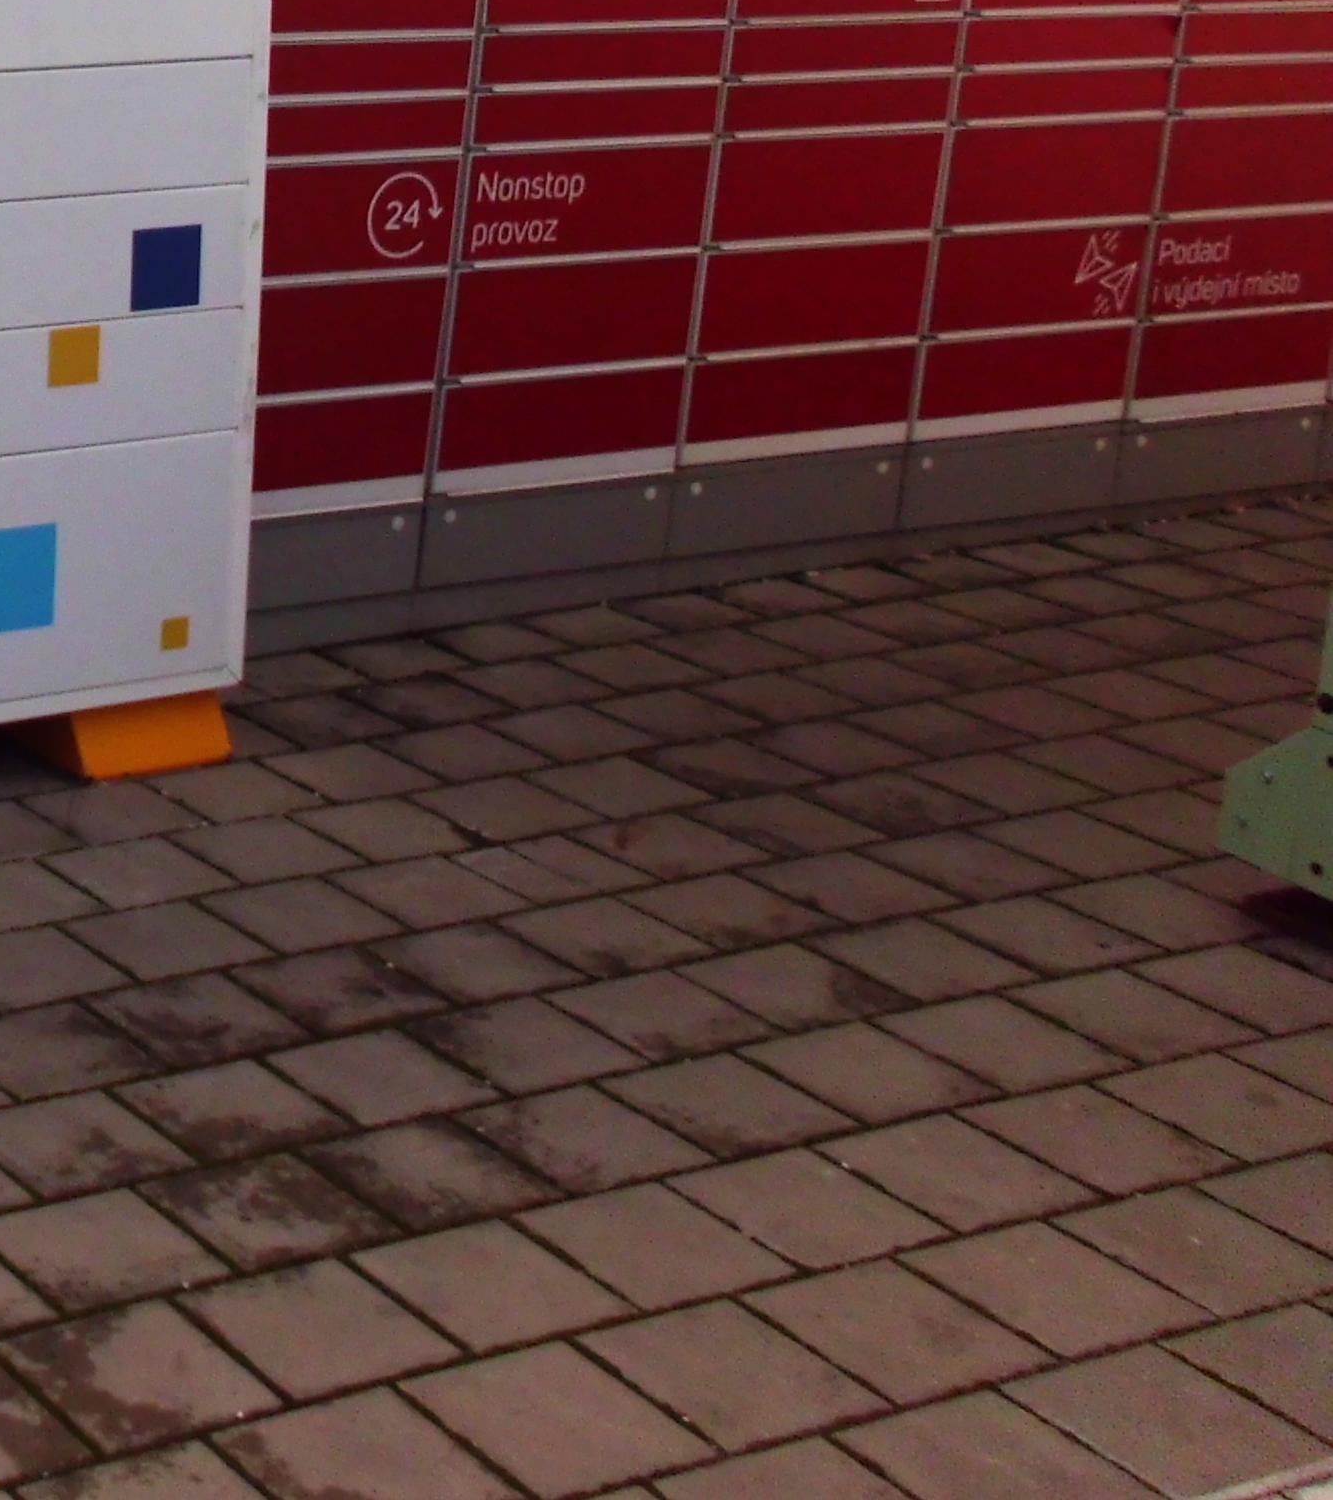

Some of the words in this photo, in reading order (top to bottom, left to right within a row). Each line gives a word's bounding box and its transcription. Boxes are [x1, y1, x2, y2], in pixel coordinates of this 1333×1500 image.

[385, 199, 421, 231] 24
[477, 171, 585, 205] Nonstop
[471, 218, 559, 253] provoz
[1158, 235, 1233, 267] Podací
[1162, 274, 1241, 308] výdejní
[1243, 269, 1301, 298] místo
